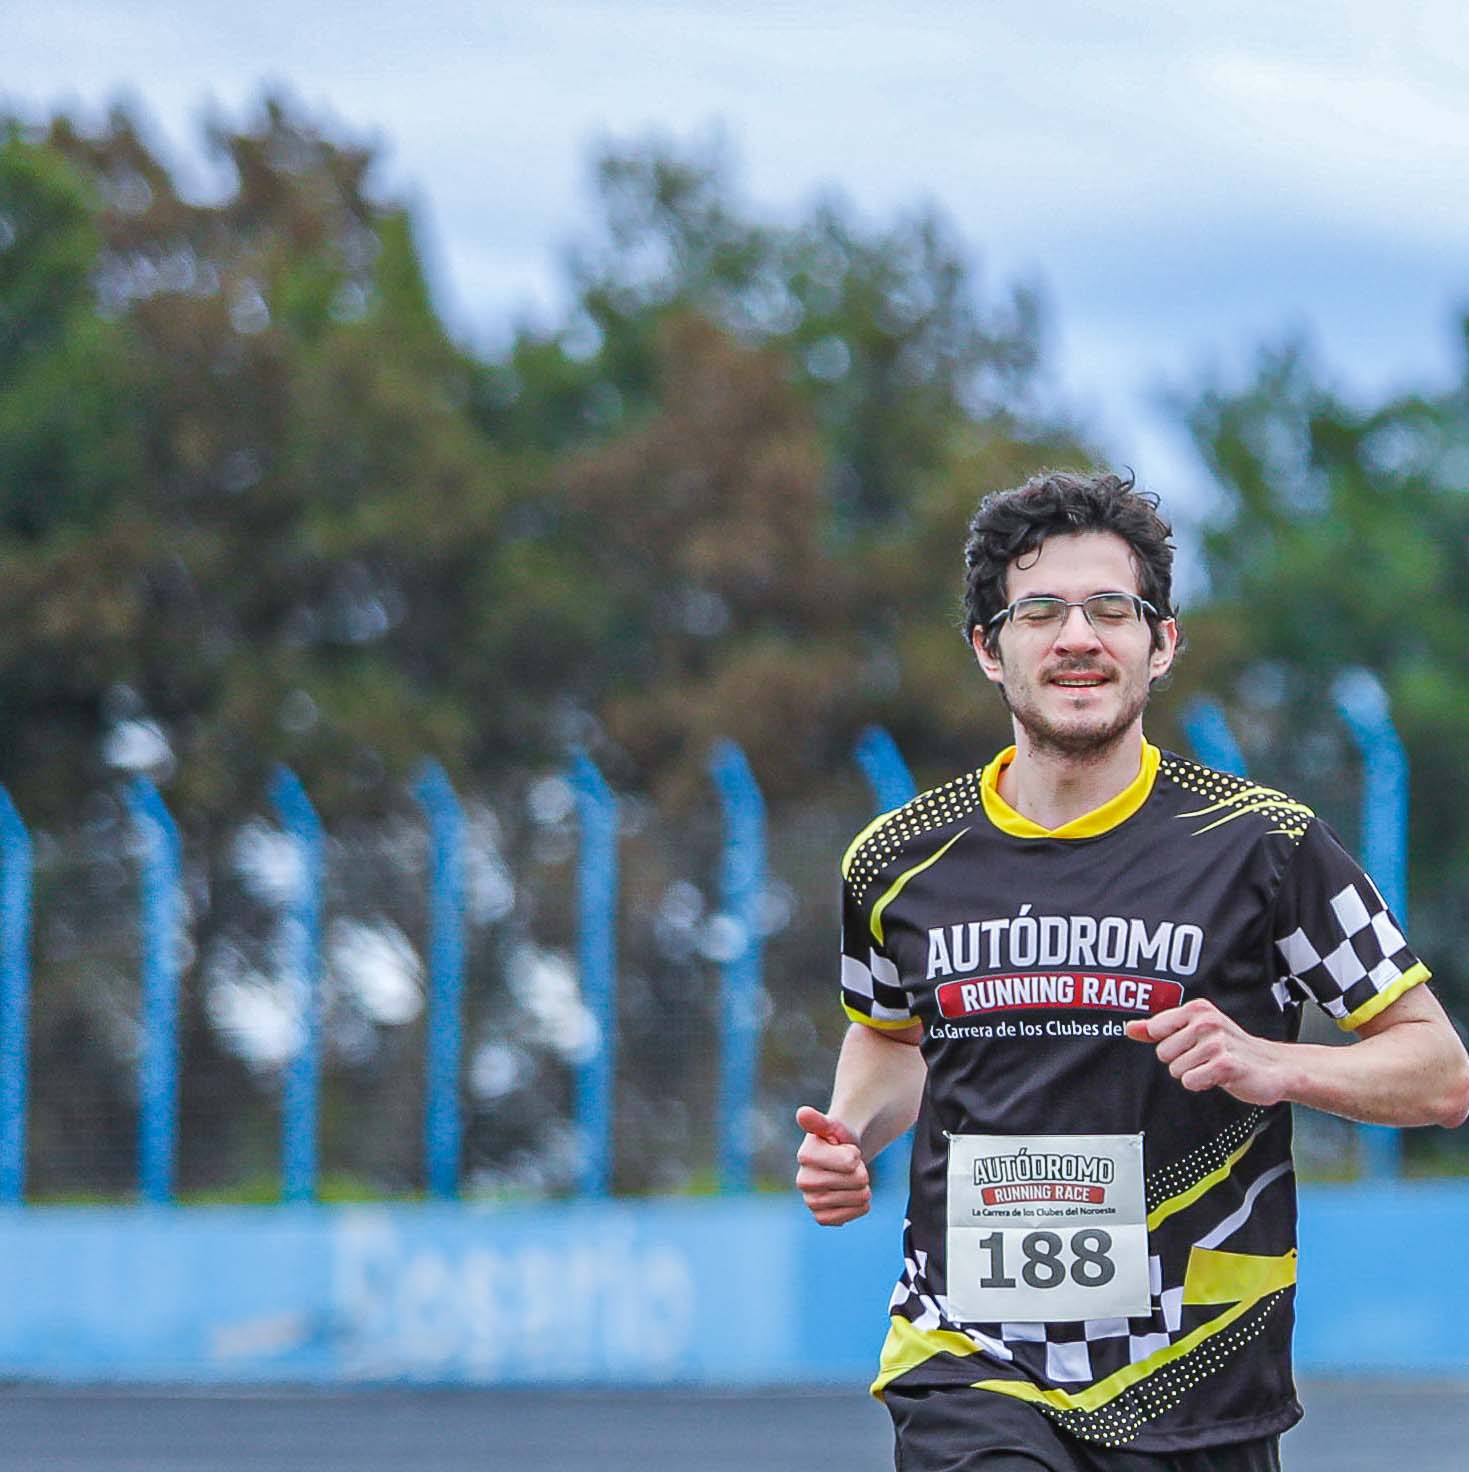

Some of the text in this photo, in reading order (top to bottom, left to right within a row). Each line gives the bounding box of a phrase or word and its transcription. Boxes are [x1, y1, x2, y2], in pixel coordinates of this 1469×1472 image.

[925, 903, 1204, 980] AUTÓDROMO
[960, 975, 1153, 1013] RUNNING RACE
[930, 1020, 1127, 1039] La Carrera de los Clubes del
[973, 1147, 1115, 1186] AUTÓDROMO
[971, 1207, 1116, 1217] La Carrera de los Clubes del Noroeste
[994, 1185, 1090, 1203] RUNNING RACE
[979, 1229, 1116, 1289] 188
